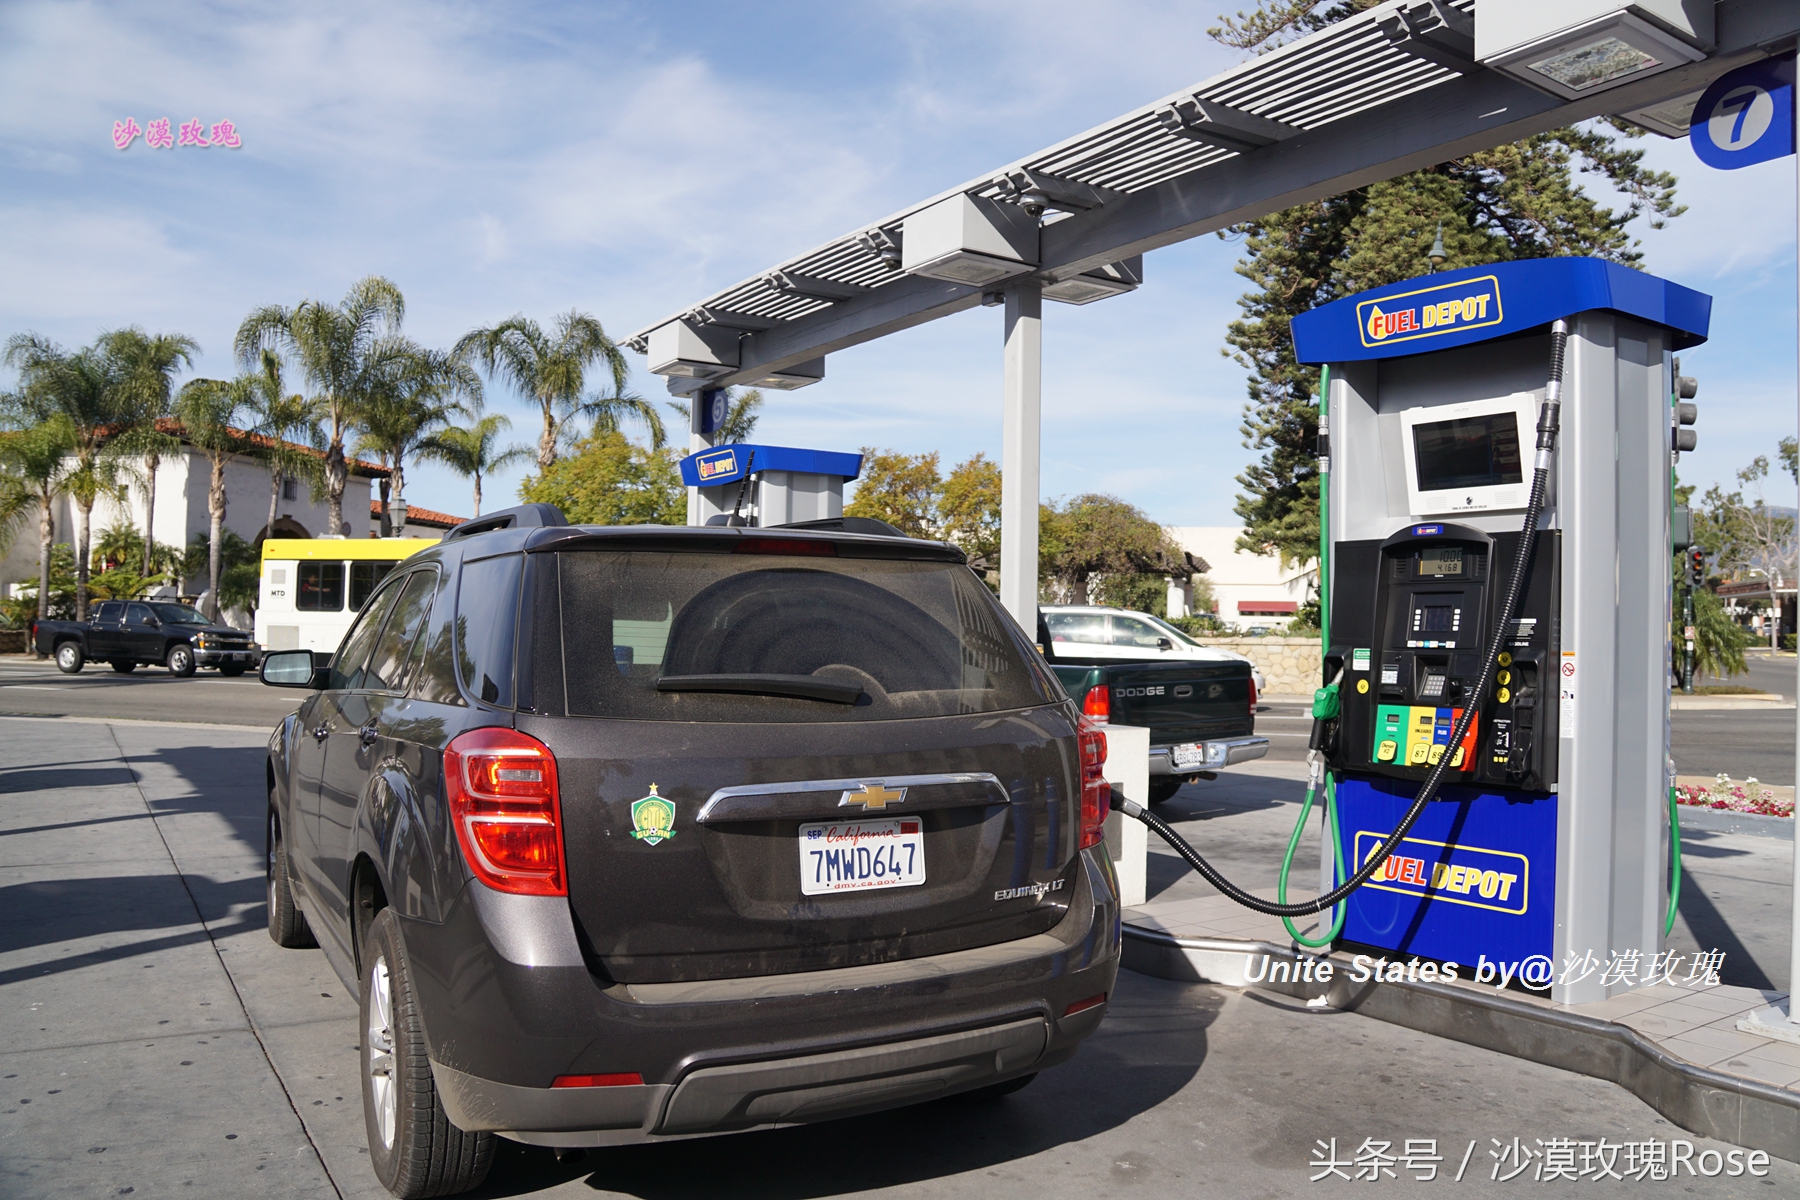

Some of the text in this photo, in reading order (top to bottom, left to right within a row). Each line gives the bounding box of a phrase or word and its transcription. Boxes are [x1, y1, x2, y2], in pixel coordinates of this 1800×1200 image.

[1723, 90, 1757, 144] 7
[1373, 293, 1491, 338] FUEL DEPOT
[701, 457, 734, 476] FUEL DEPOT
[1116, 686, 1165, 698] DODGE
[1414, 750, 1425, 758] 87
[807, 829, 822, 840] SEP
[826, 825, 901, 846] California
[810, 843, 916, 883] 7MWD647
[834, 879, 897, 889] dmv.ca.gov
[994, 879, 1065, 901] EQUINOX LT
[1430, 861, 1517, 901] DEPOT
